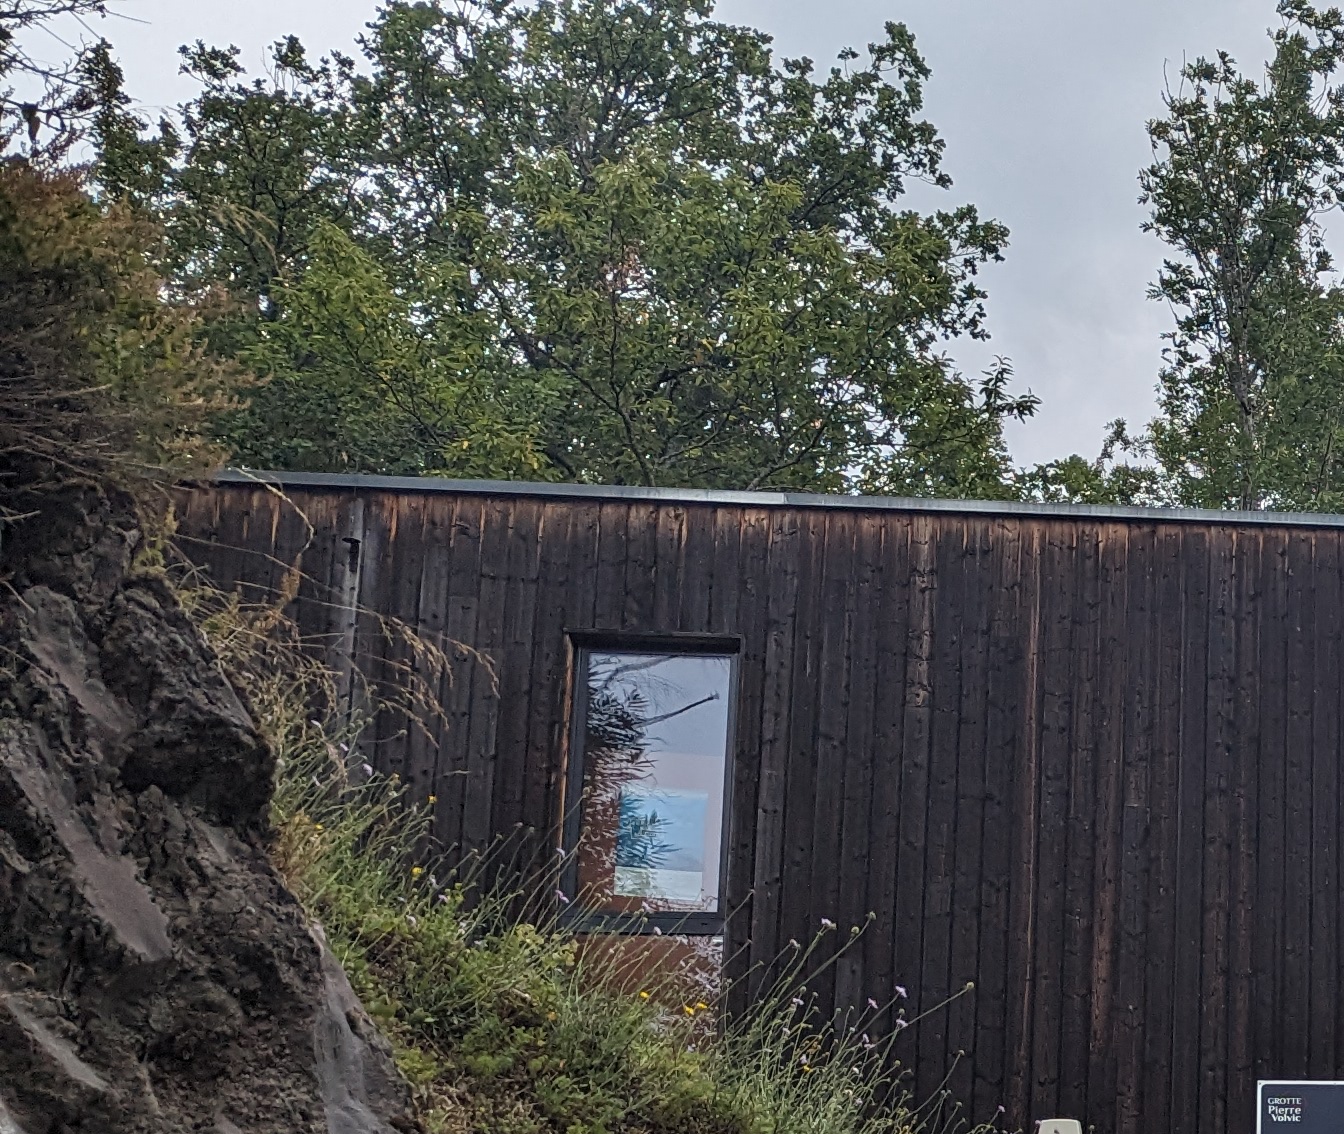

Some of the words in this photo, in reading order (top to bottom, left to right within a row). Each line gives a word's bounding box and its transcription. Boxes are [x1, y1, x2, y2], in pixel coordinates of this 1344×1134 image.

[1267, 1097, 1302, 1105] GROTTE
[1268, 1105, 1302, 1115] Pierre
[1271, 1113, 1302, 1122] Volvic
